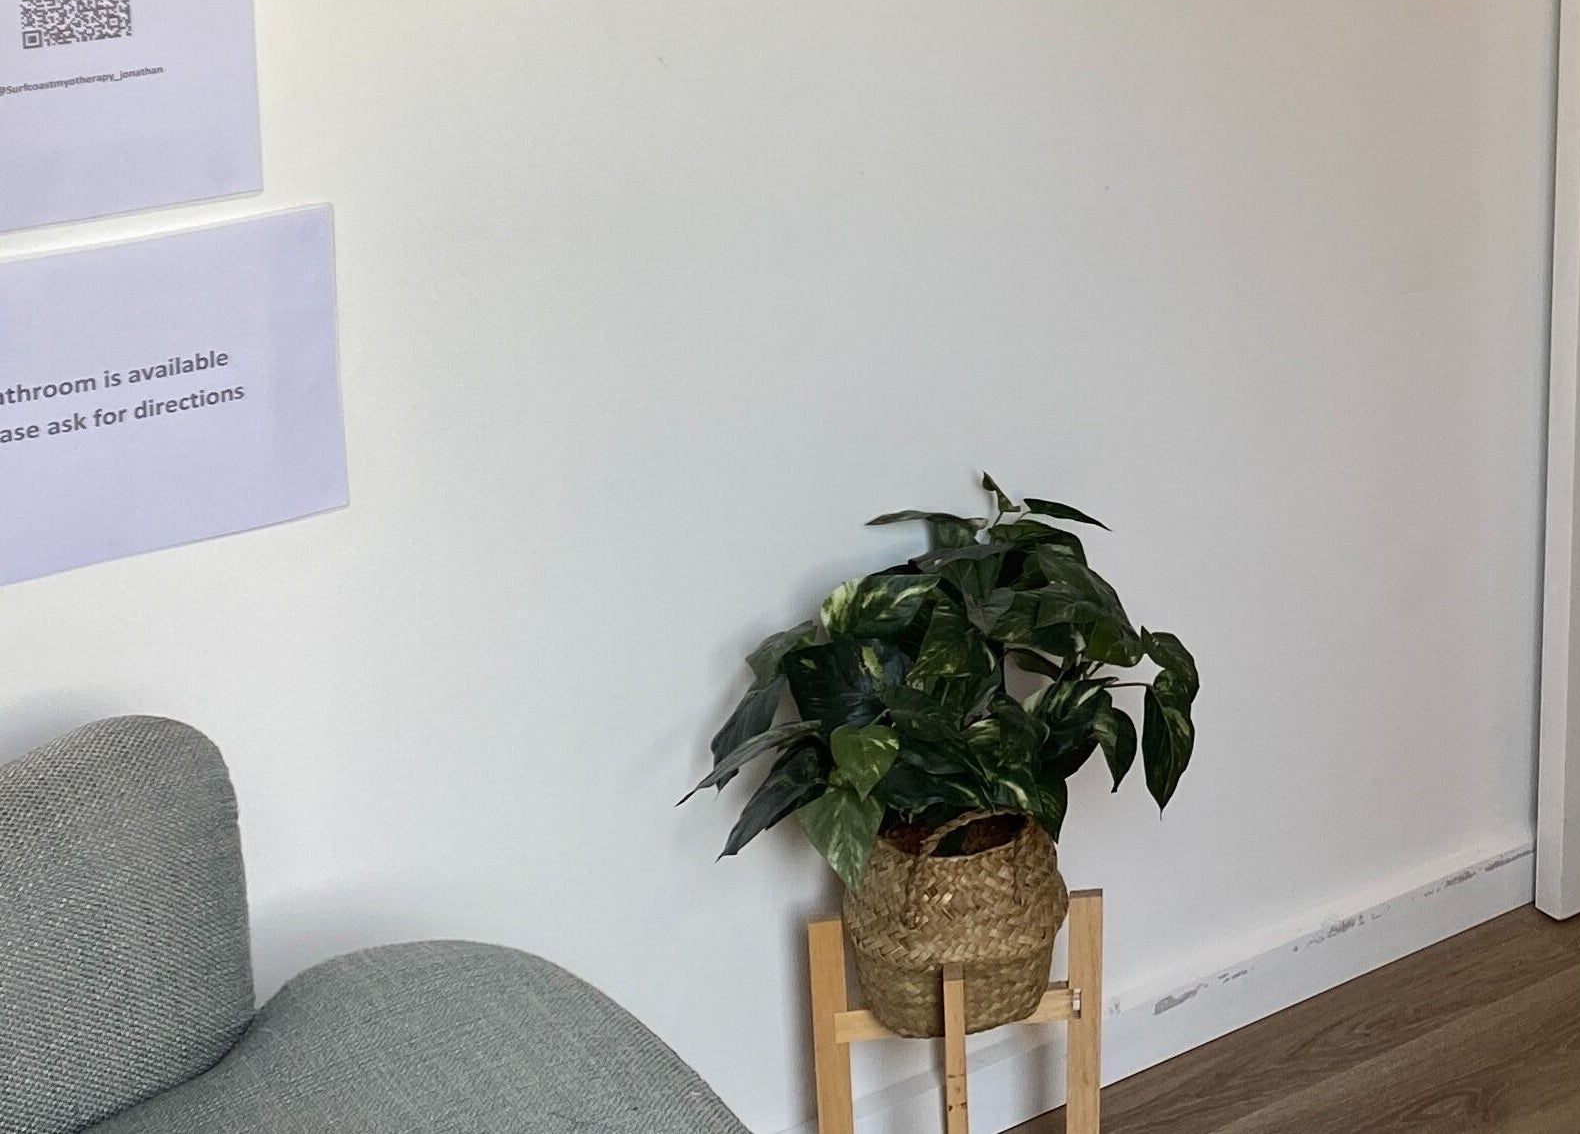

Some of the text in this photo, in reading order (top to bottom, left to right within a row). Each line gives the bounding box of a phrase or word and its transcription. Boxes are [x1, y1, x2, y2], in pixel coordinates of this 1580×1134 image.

[103, 370, 122, 388] is
[128, 350, 230, 384] available
[47, 412, 87, 436] ask
[94, 407, 128, 428] for
[134, 385, 246, 420] directions
